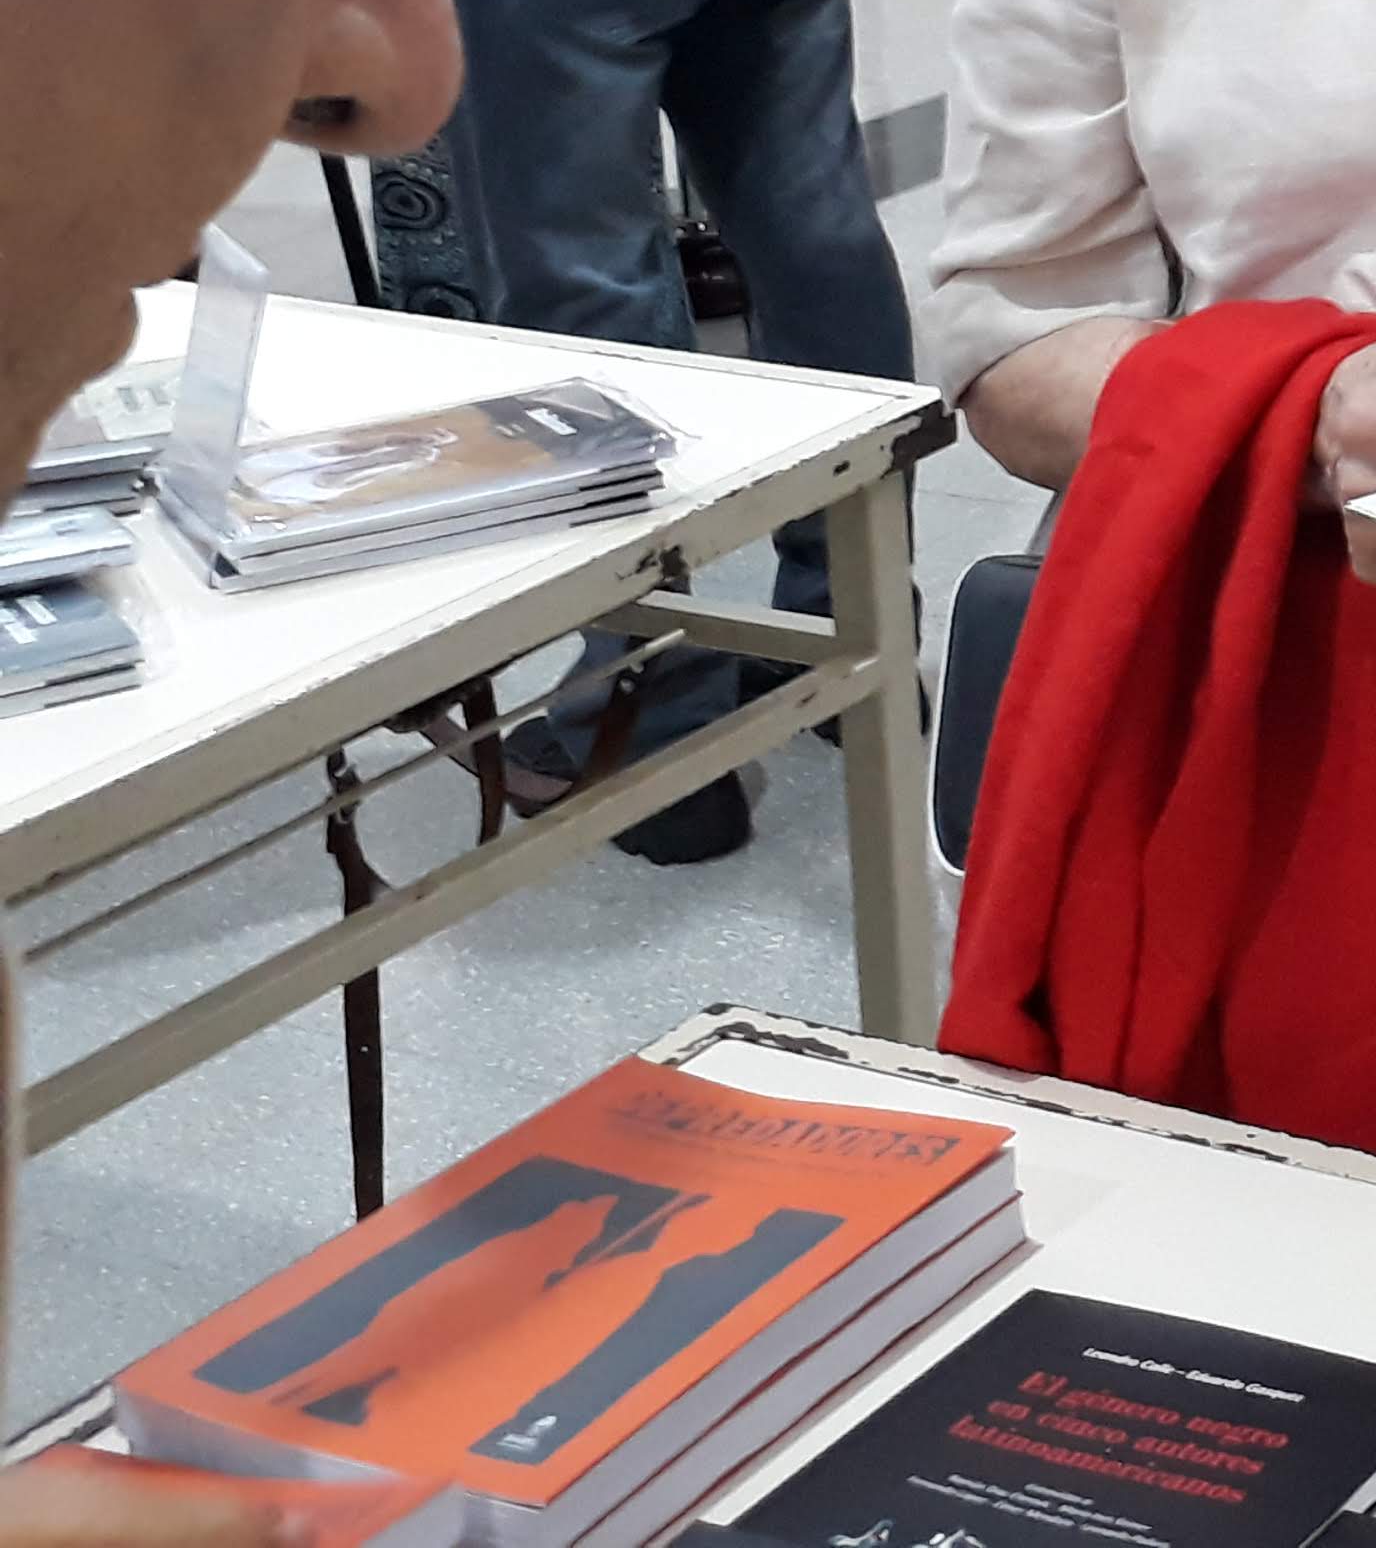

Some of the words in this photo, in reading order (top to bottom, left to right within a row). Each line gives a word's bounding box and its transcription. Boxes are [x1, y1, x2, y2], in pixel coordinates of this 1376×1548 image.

[987, 1401, 1032, 1421] en
[1036, 1412, 1129, 1445] cinco
[1134, 1436, 1265, 1475] autores
[1018, 1371, 1069, 1396] El
[1187, 1416, 1290, 1448] negro
[949, 1414, 1247, 1502] latinoamericanos
